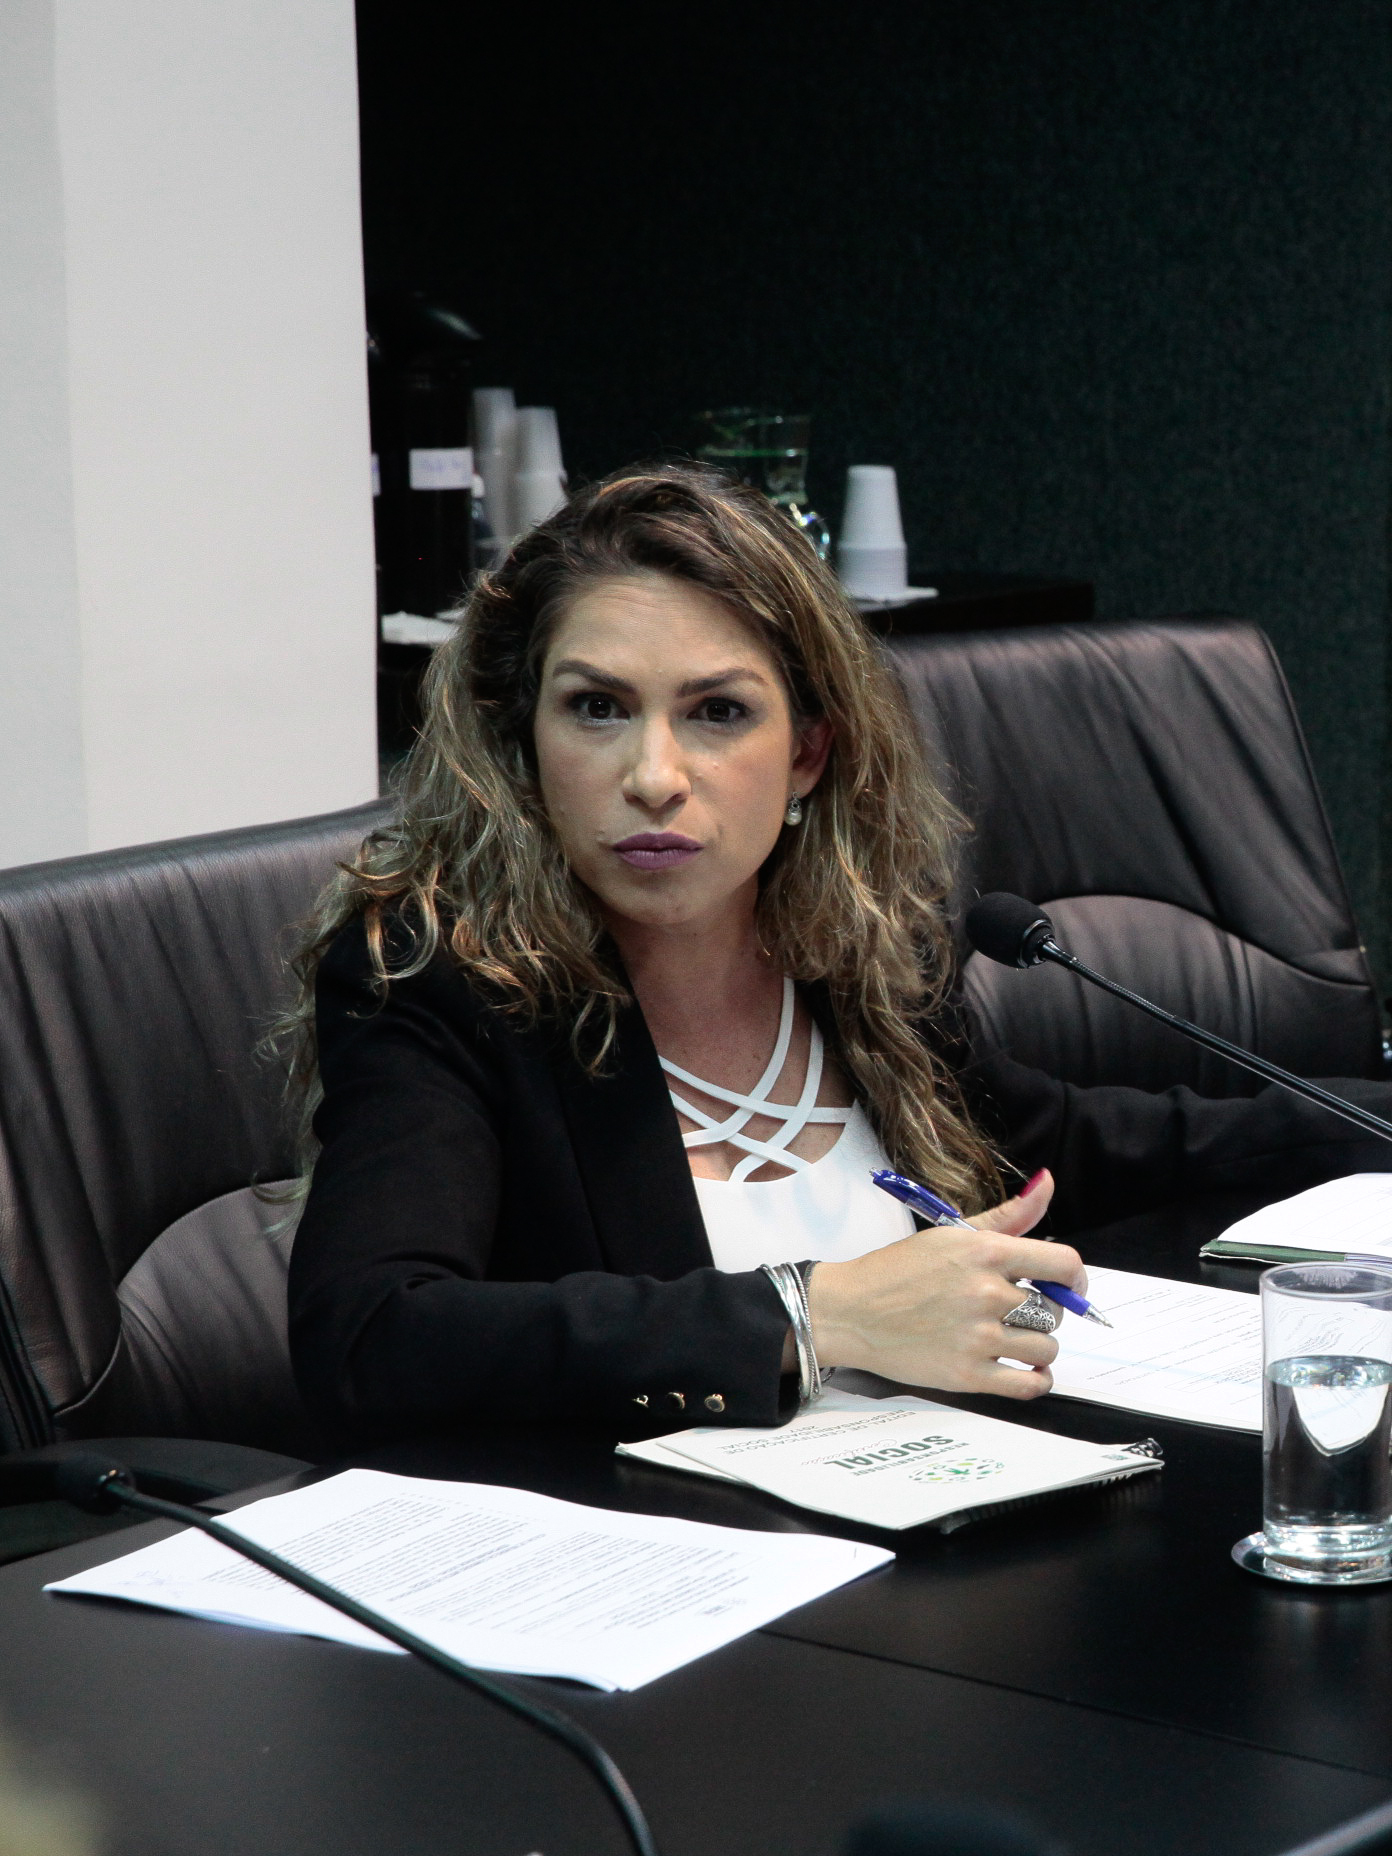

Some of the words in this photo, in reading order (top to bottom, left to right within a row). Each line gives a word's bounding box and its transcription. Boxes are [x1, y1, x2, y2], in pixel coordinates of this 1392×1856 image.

[774, 1409, 904, 1440] RESPONSABILIDADE
[874, 1411, 916, 1426] EDITAL
[790, 1425, 816, 1433] 2017
[717, 1438, 769, 1449] SOCIAL
[724, 1446, 745, 1454] DE
[823, 1435, 954, 1469] SOCIAL
[851, 1442, 969, 1476] RESPONSABILIDADE
